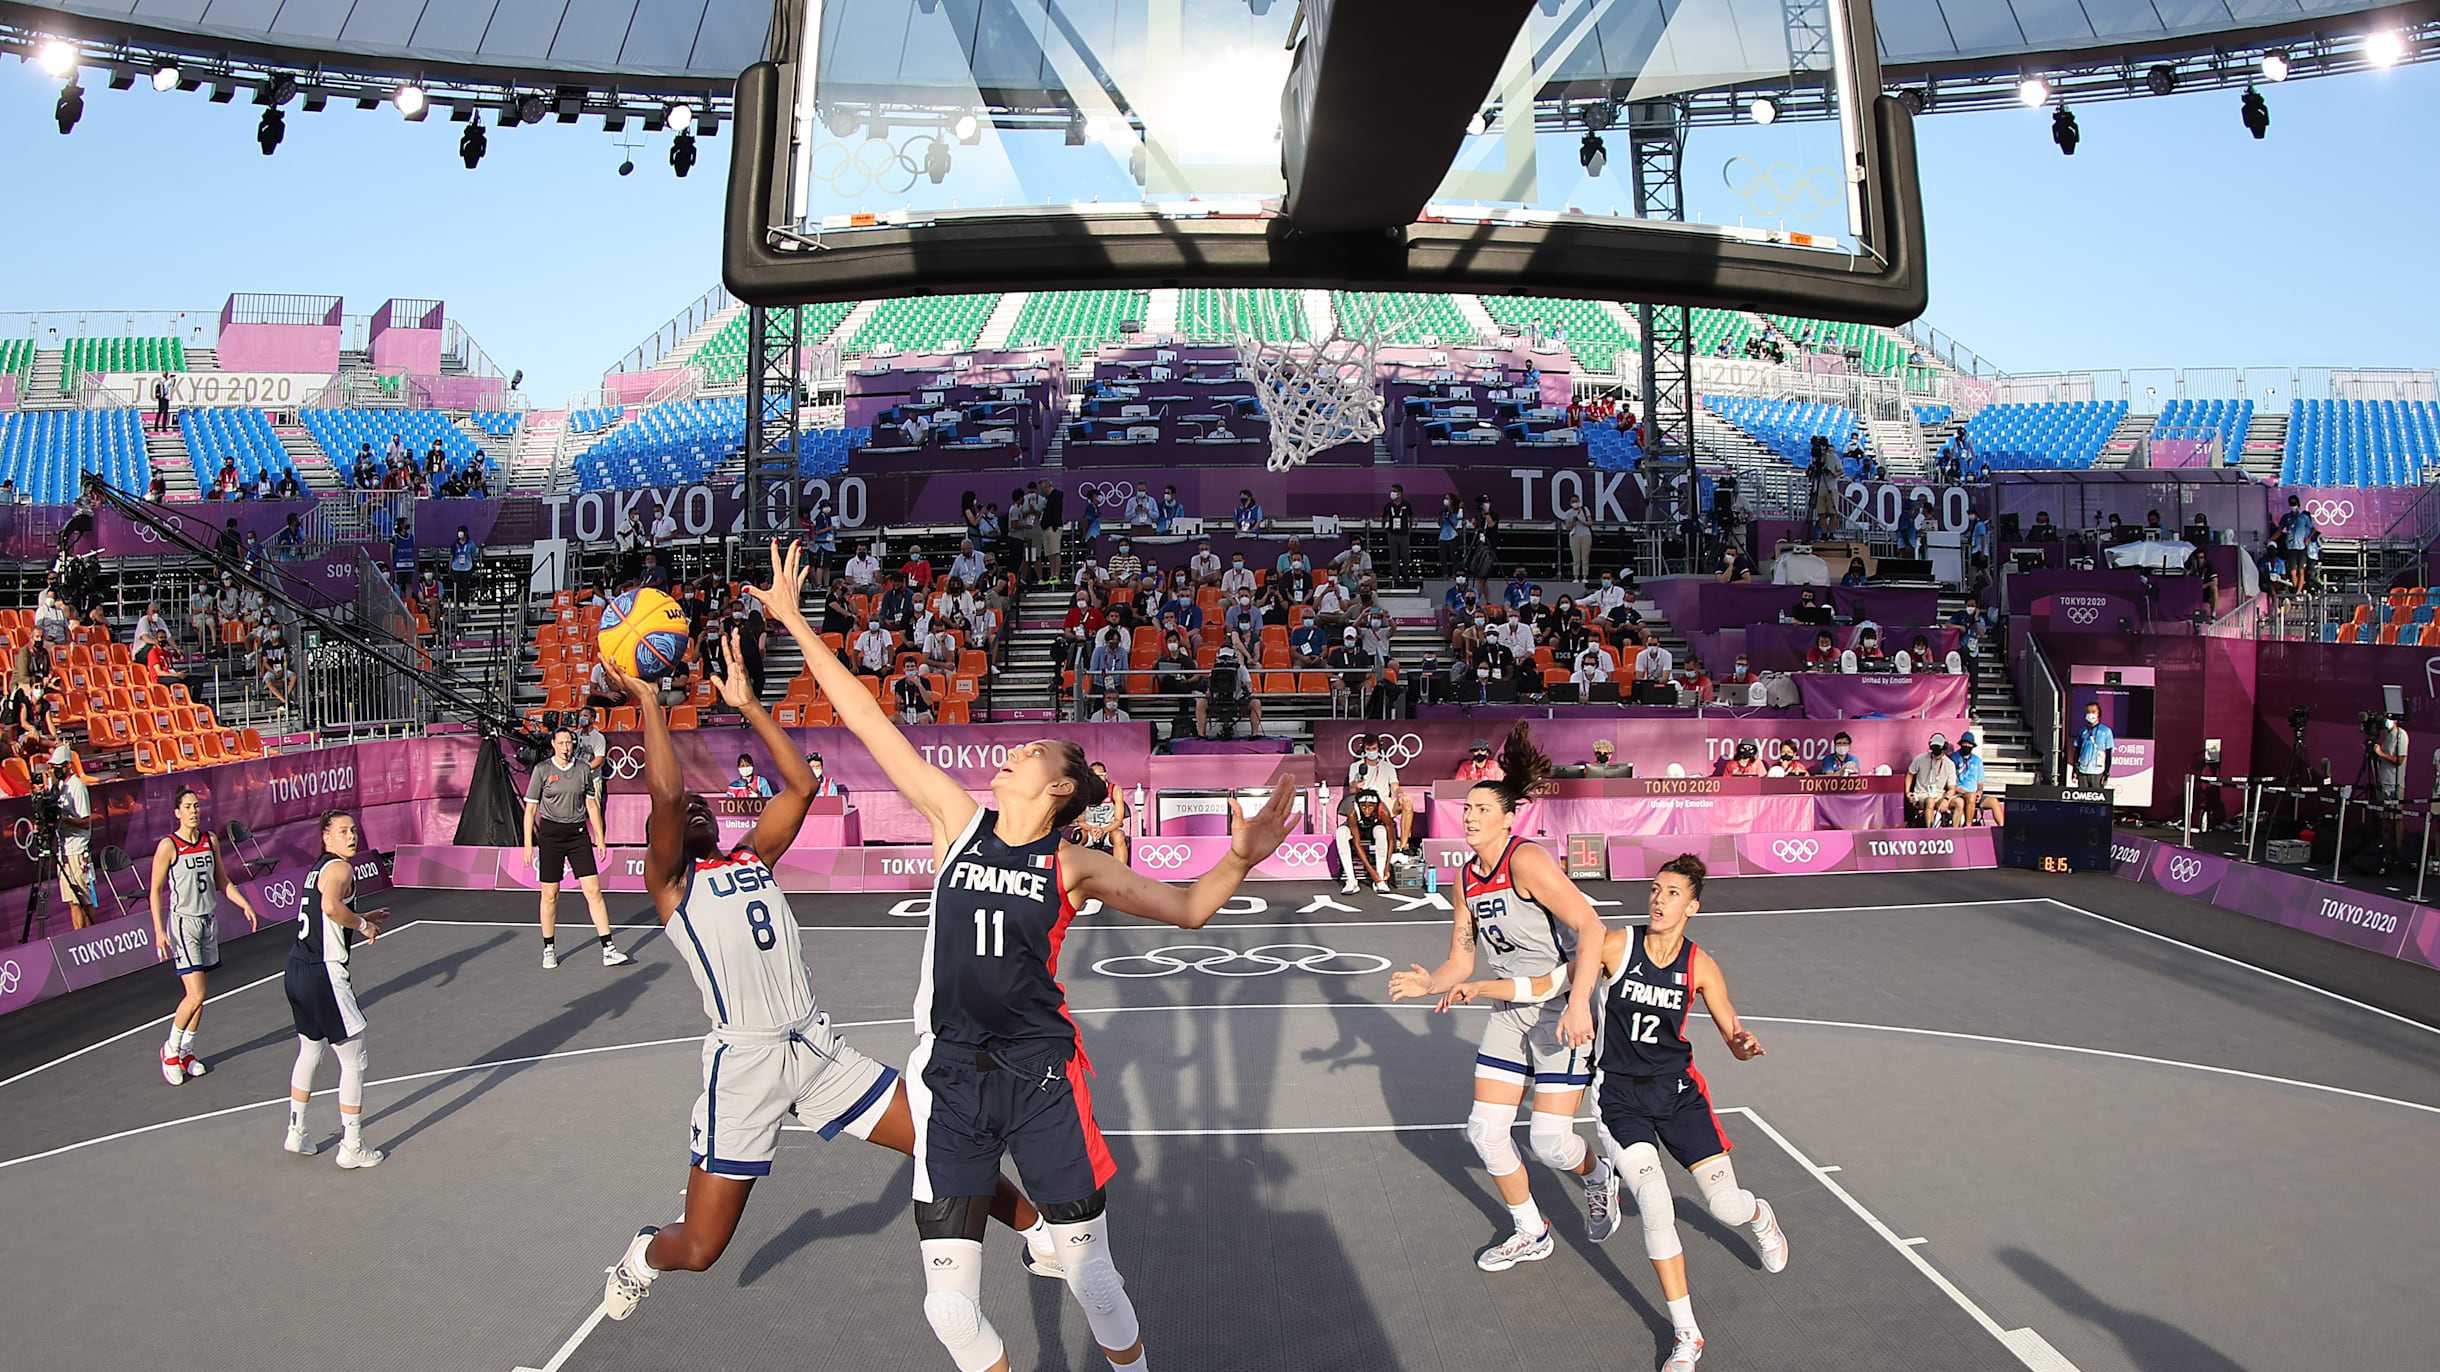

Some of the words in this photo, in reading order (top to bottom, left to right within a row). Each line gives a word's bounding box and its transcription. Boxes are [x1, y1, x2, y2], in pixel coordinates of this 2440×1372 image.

[227, 377, 291, 401] 2020
[542, 486, 714, 542] TOKYO
[327, 564, 352, 578] S09
[2060, 597, 2086, 606] TOKYO
[2087, 598, 2107, 606] 2020
[921, 745, 1008, 769] TOKYO
[1705, 738, 1782, 761] TOYO
[2111, 757, 2144, 766] MOMENT
[269, 772, 318, 804] TOKYO
[320, 766, 354, 794] 2020
[1645, 781, 1687, 793] TOKYO
[1690, 780, 1721, 793] 2020
[1800, 779, 1838, 791] TOKYO
[1841, 778, 1869, 790] 2020
[718, 800, 763, 813] TOKYO
[1651, 800, 1674, 808] United
[1675, 800, 1684, 809] by
[1685, 800, 1714, 808] Emotion
[2072, 792, 2106, 801] OMEGA
[1176, 804, 1204, 812] TOKYO
[2020, 804, 2037, 812] USA
[2080, 806, 2096, 815] FRA
[1869, 841, 1917, 856] TOKYO
[1919, 839, 1954, 855] 2020
[2115, 846, 2141, 863] 2020
[185, 855, 213, 870] USA
[1440, 851, 1475, 867] TOK
[355, 861, 379, 880] 2020
[196, 872, 207, 894] 5
[708, 866, 777, 898] USA
[948, 861, 1048, 903] FRANCE
[1473, 897, 1507, 919] SA
[2320, 898, 2364, 925] TOKYO
[2362, 910, 2397, 934] 2020
[746, 900, 777, 951] 8
[974, 908, 1005, 957] 11
[68, 938, 116, 966] TOKYO
[114, 928, 149, 953] 2020
[1479, 924, 1516, 956] 13
[1620, 978, 1684, 1010] FRANCE
[1630, 1012, 1661, 1044] 12
